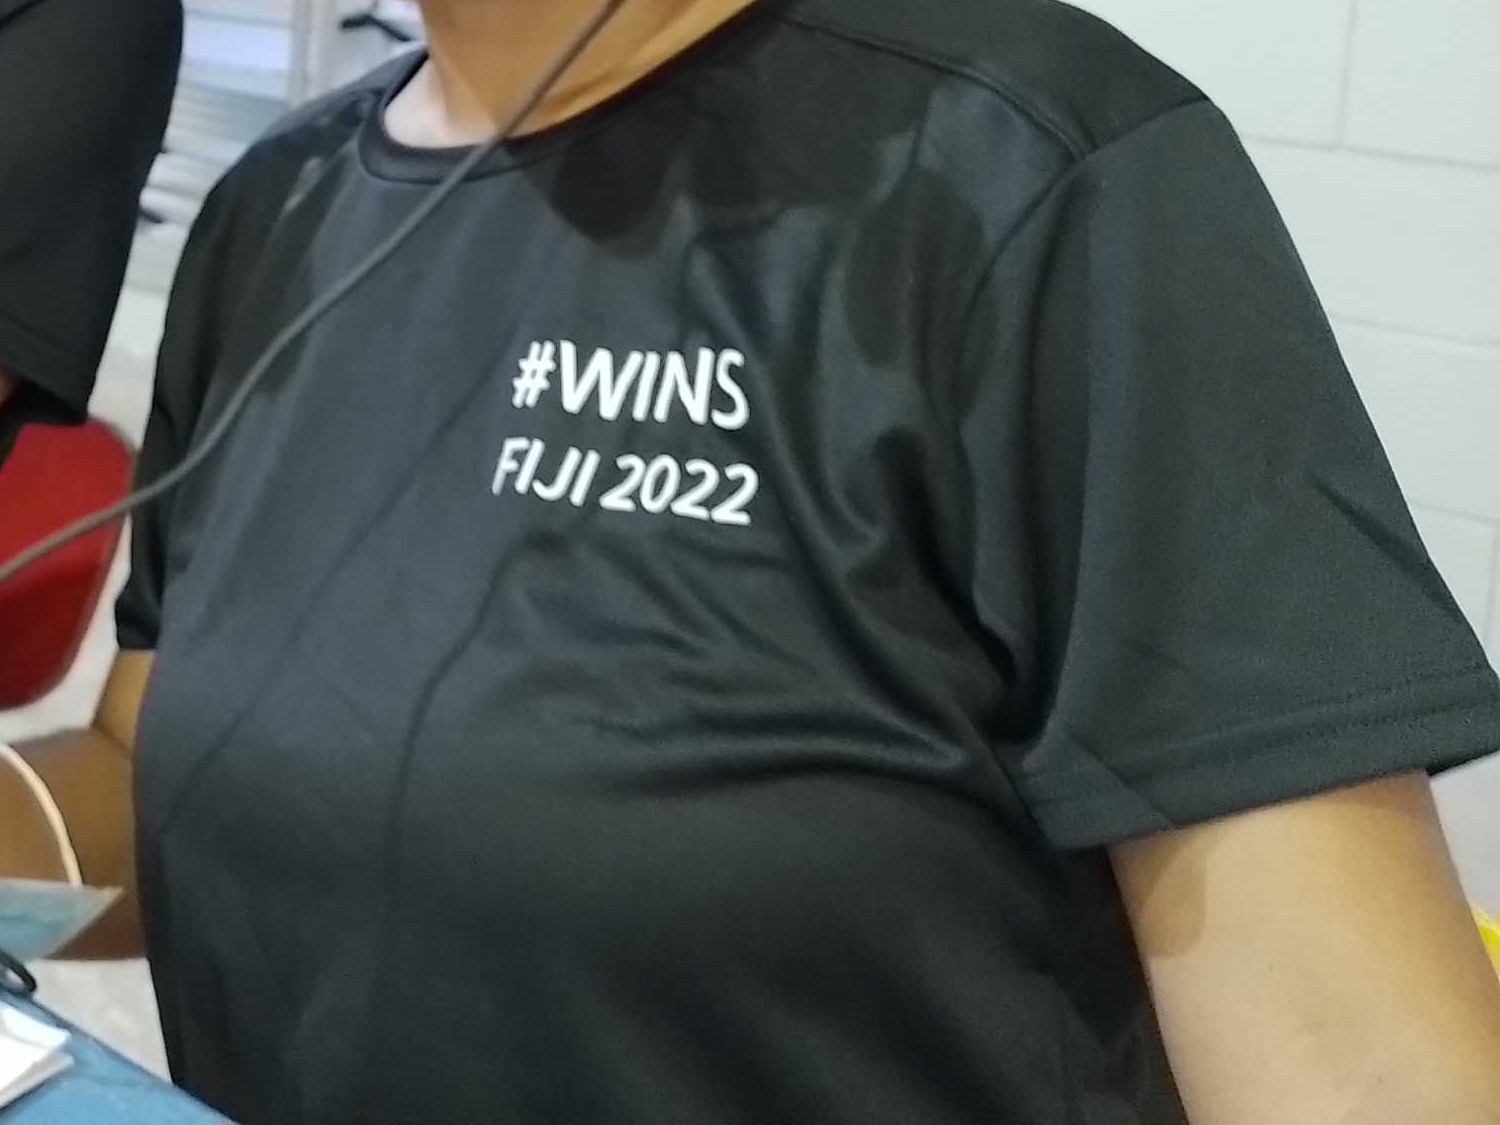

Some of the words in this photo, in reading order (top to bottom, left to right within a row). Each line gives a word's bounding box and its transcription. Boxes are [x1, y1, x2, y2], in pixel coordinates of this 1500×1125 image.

[511, 339, 750, 431] #WINS
[490, 436, 601, 508] FIJI
[600, 453, 759, 527] 2022
